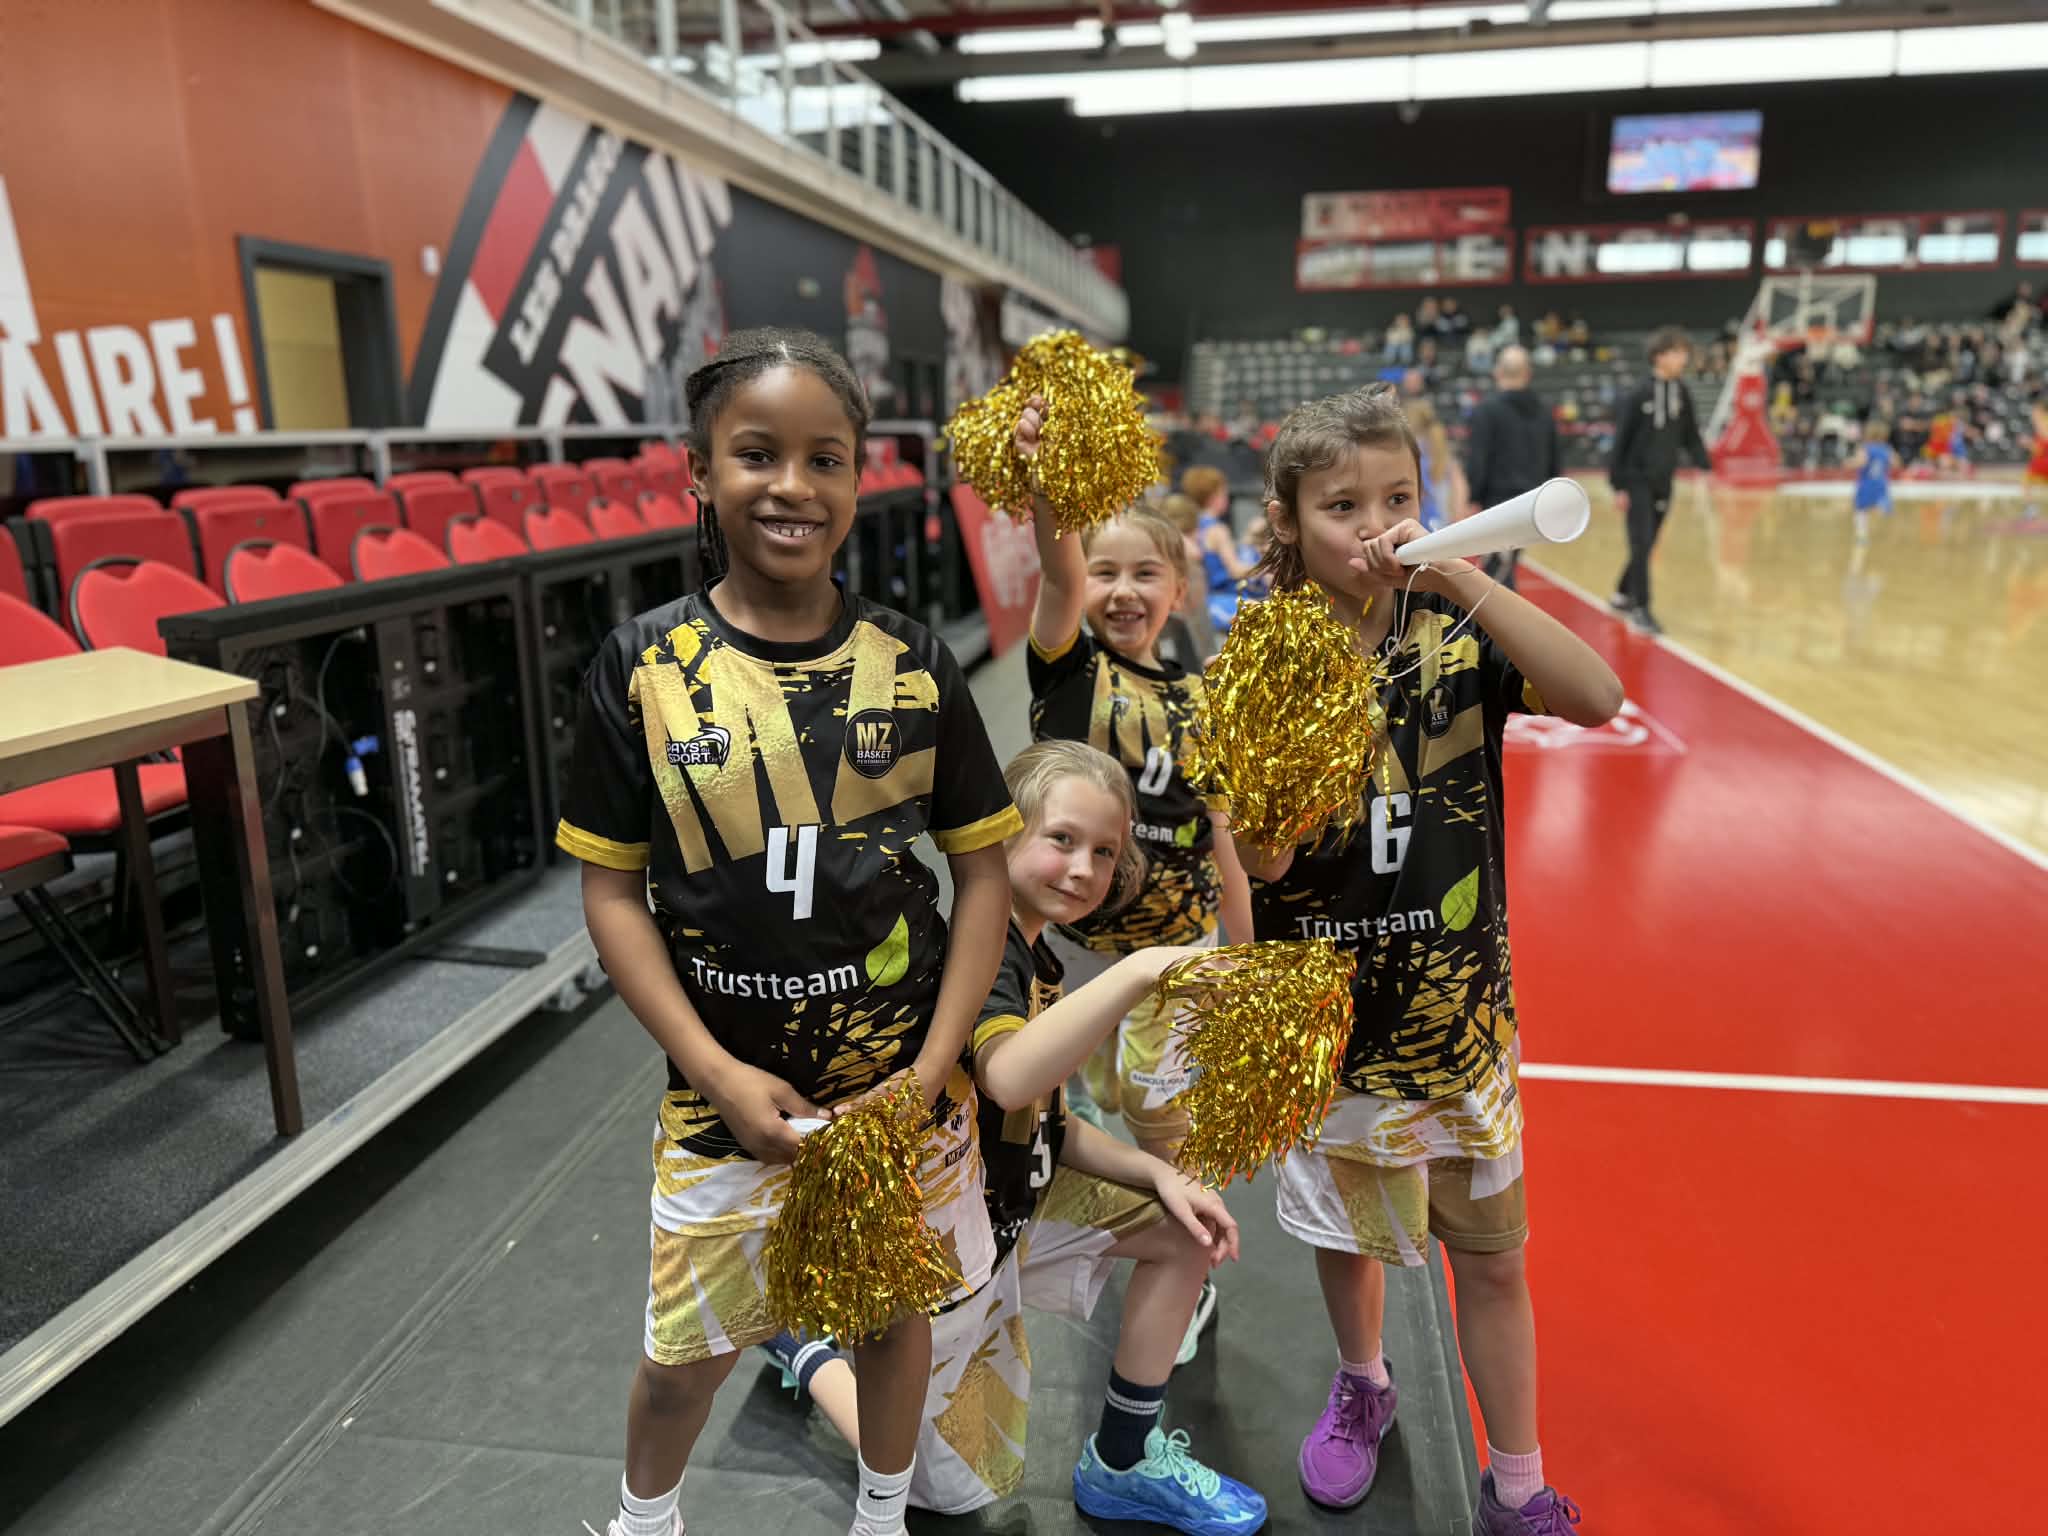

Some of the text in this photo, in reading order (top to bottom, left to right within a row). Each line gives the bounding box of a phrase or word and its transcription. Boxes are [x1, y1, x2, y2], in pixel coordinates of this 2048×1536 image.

[855, 722, 893, 751] MZ
[857, 750, 892, 759] BASKET
[1370, 792, 1413, 875] 6
[765, 825, 819, 921] 4
[691, 956, 859, 1001] Trustteam
